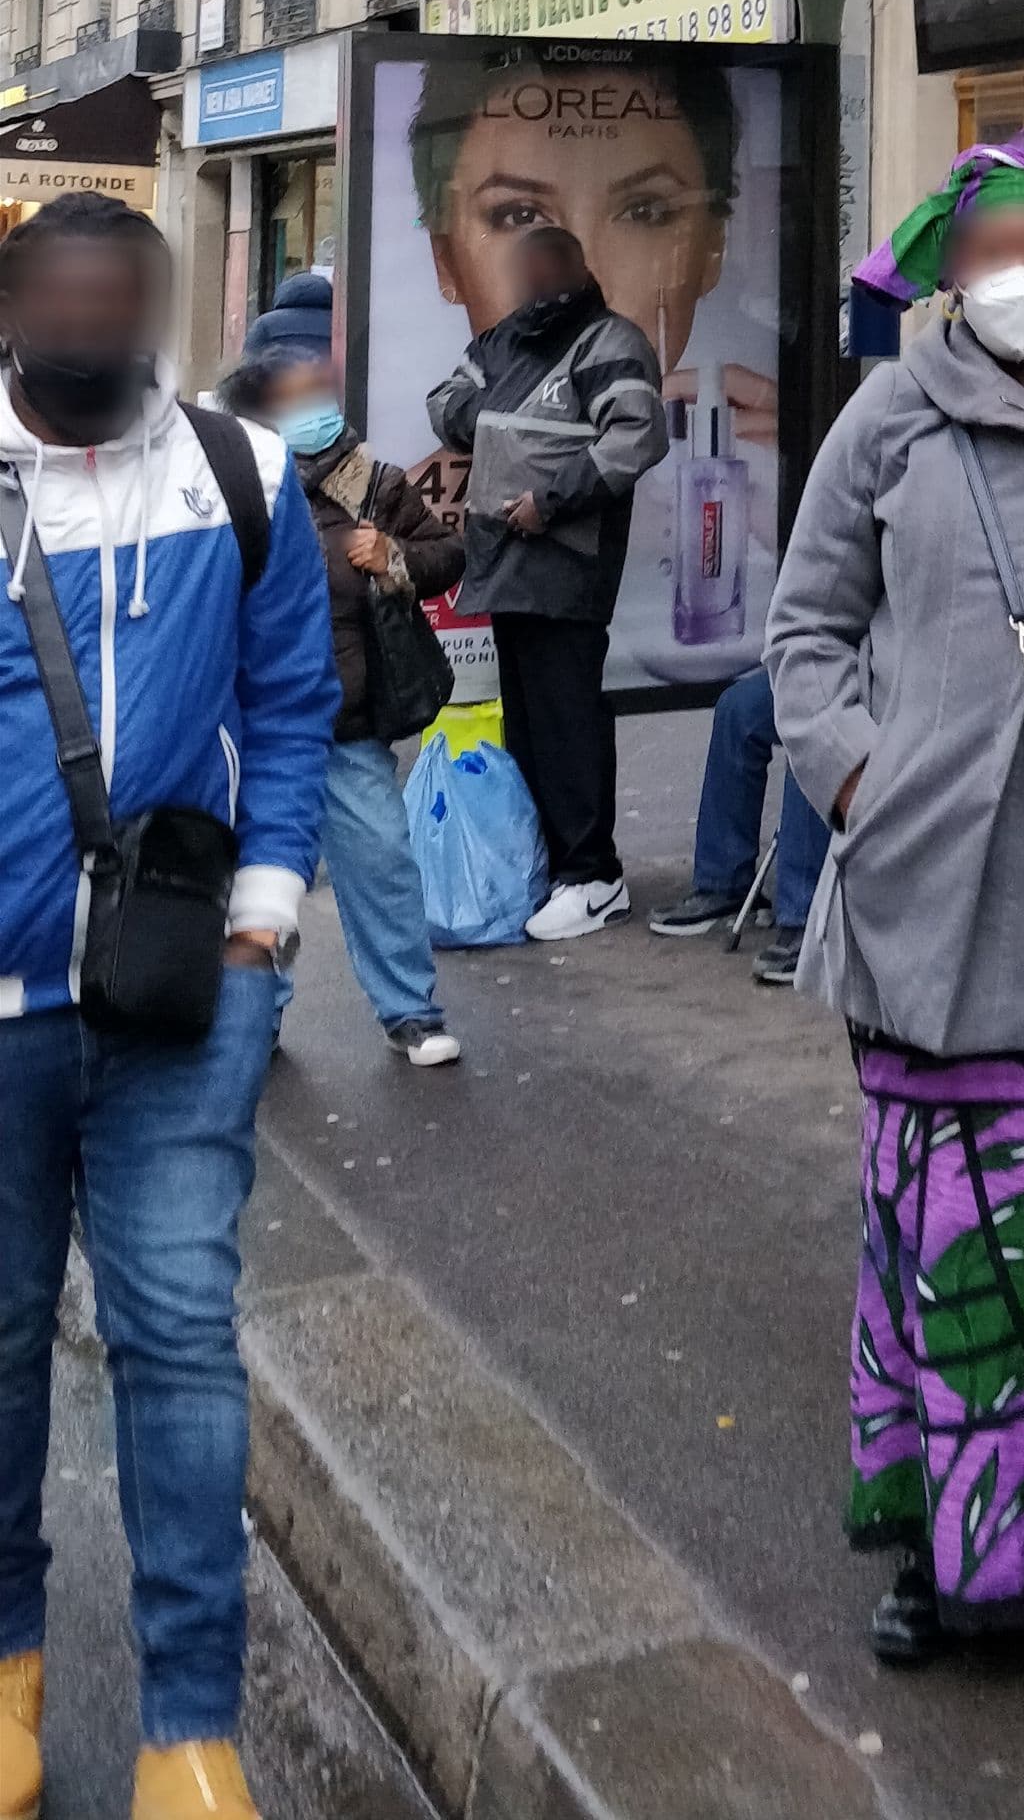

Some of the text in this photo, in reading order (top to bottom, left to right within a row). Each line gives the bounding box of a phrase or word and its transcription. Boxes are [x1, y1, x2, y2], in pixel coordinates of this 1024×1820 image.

[707, 3, 732, 38] 98
[543, 45, 633, 62] JCDecaux
[482, 83, 682, 121] L'ORÉAL
[548, 125, 619, 140] PARIS
[6, 171, 136, 192] LA ROTONDE
